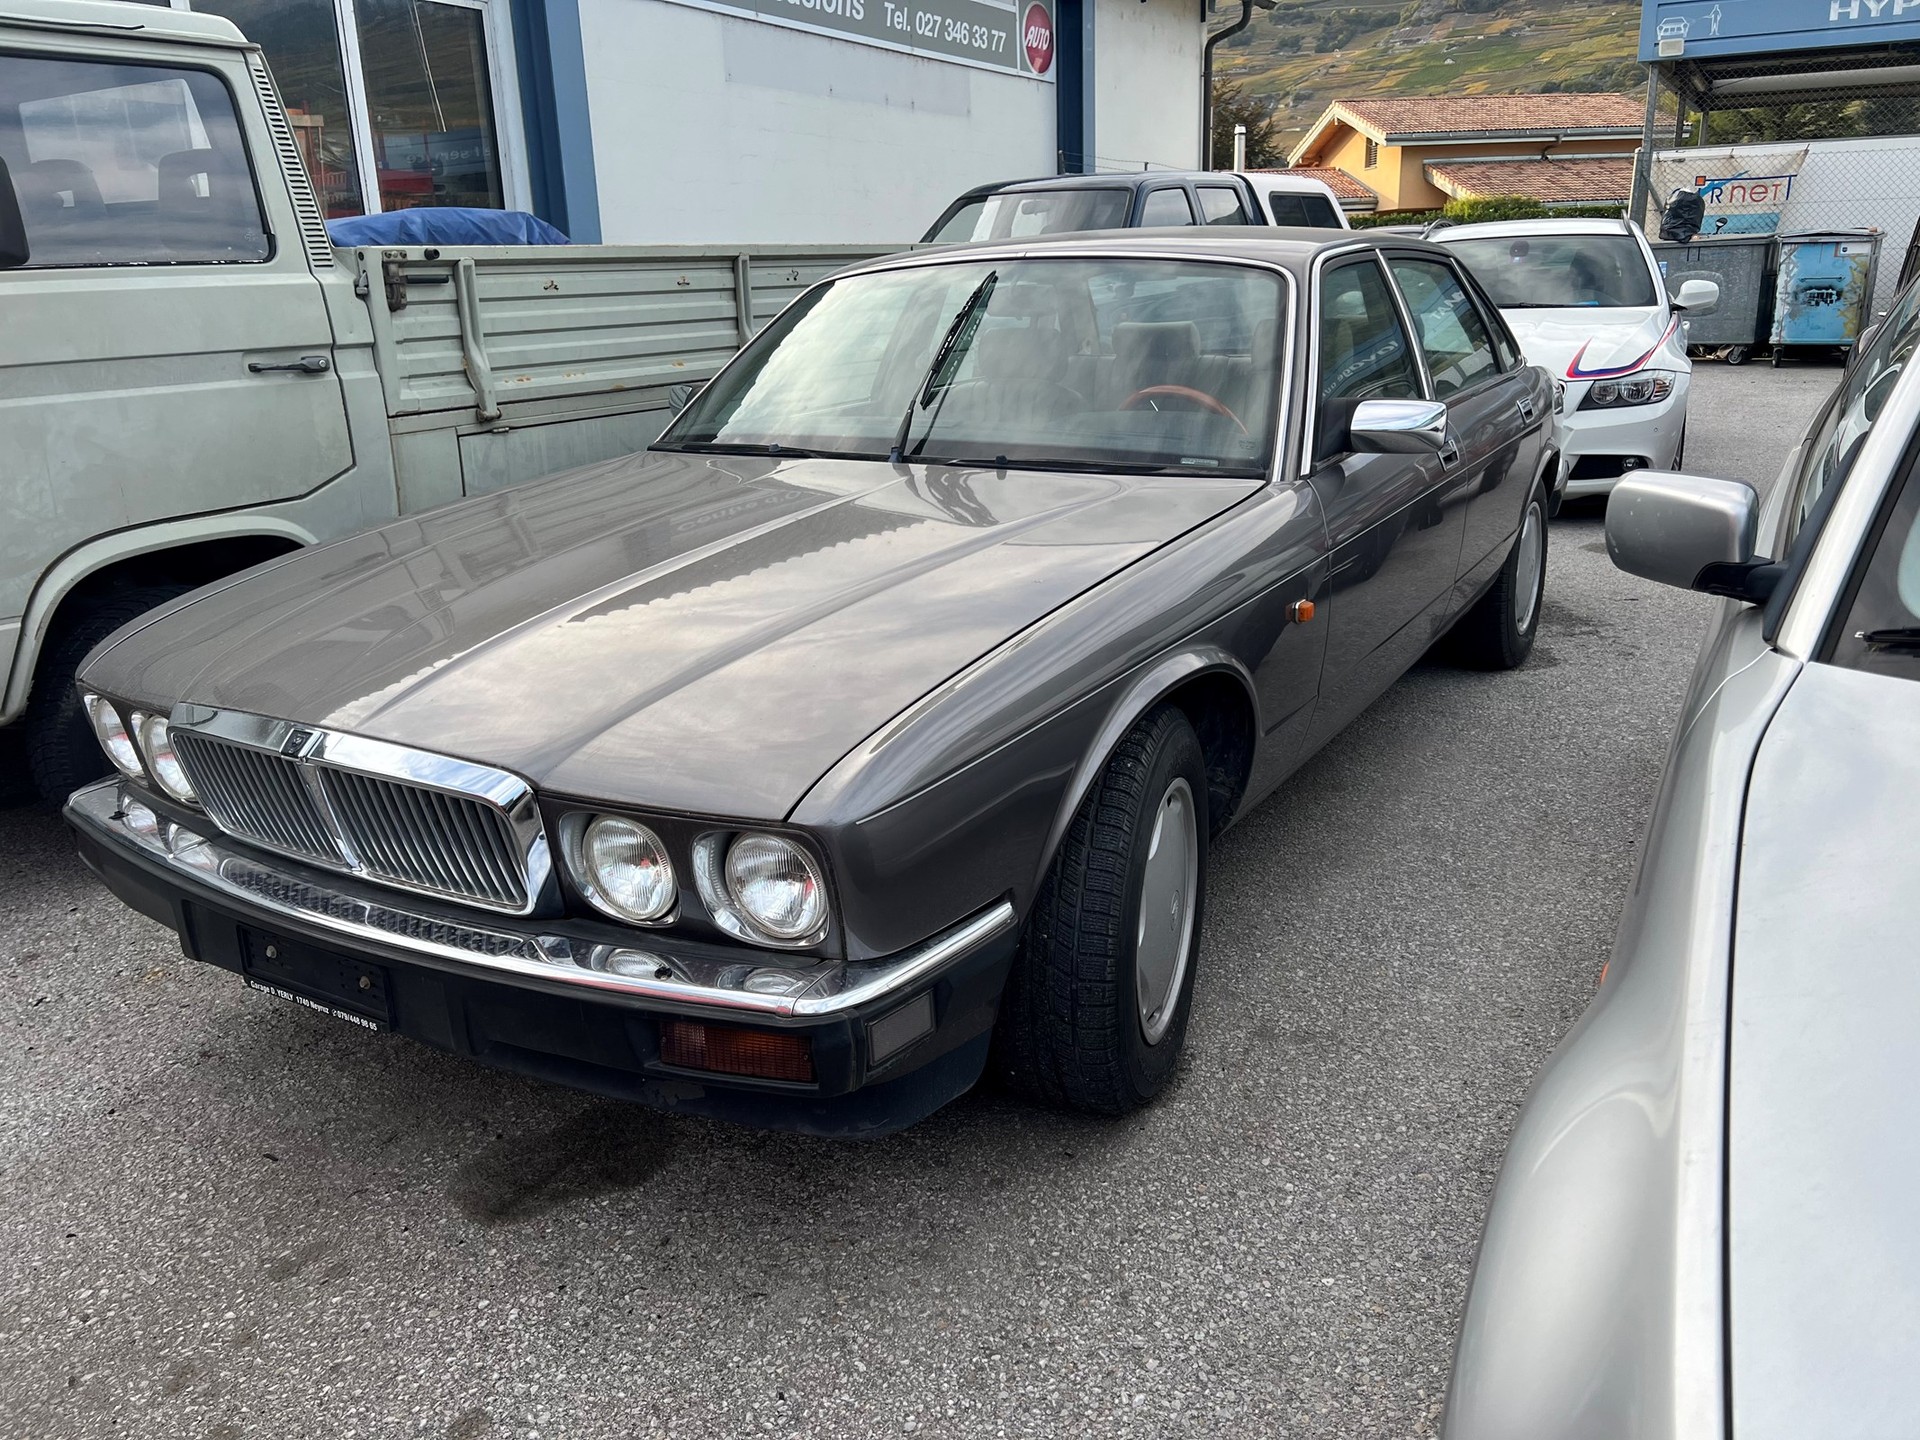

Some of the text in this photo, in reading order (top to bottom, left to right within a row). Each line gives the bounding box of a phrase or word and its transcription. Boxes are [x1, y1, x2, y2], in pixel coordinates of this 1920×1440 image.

[884, 2, 911, 32] Tel.
[915, 11, 942, 38] 027
[944, 18, 970, 46] 346
[971, 25, 988, 49] 33
[991, 29, 1007, 53] 77
[1026, 26, 1050, 50] AUTO
[250, 980, 270, 994] Garage
[276, 989, 293, 1001] YERLY
[295, 996, 310, 1007] 1740
[309, 1000, 330, 1015] Neyruz
